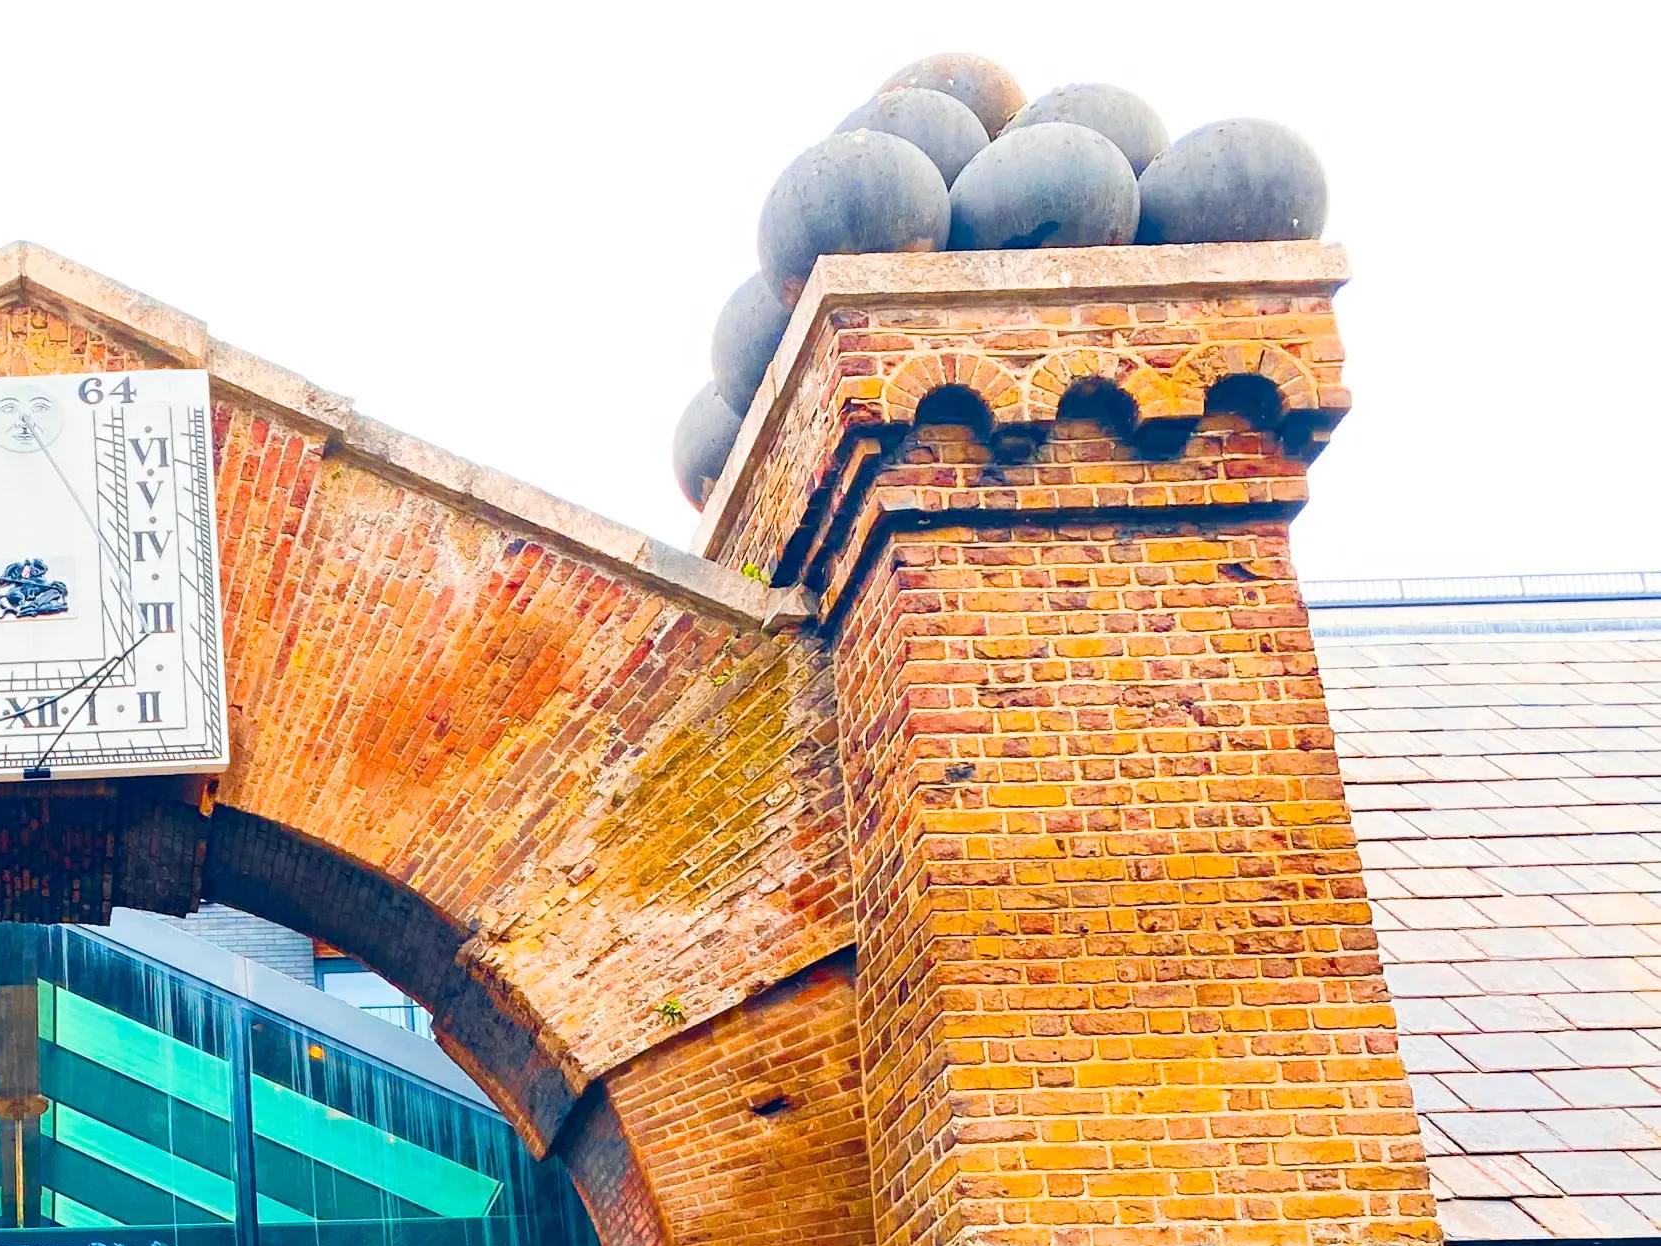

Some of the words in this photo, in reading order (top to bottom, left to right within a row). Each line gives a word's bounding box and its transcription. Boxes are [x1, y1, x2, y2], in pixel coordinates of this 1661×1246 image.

[77, 377, 137, 406] 64
[128, 436, 170, 469] VI
[135, 480, 164, 510] V
[132, 530, 173, 562] IV
[139, 602, 175, 634] III
[5, 695, 59, 729] XII
[85, 694, 99, 726] I
[136, 691, 163, 723] II
